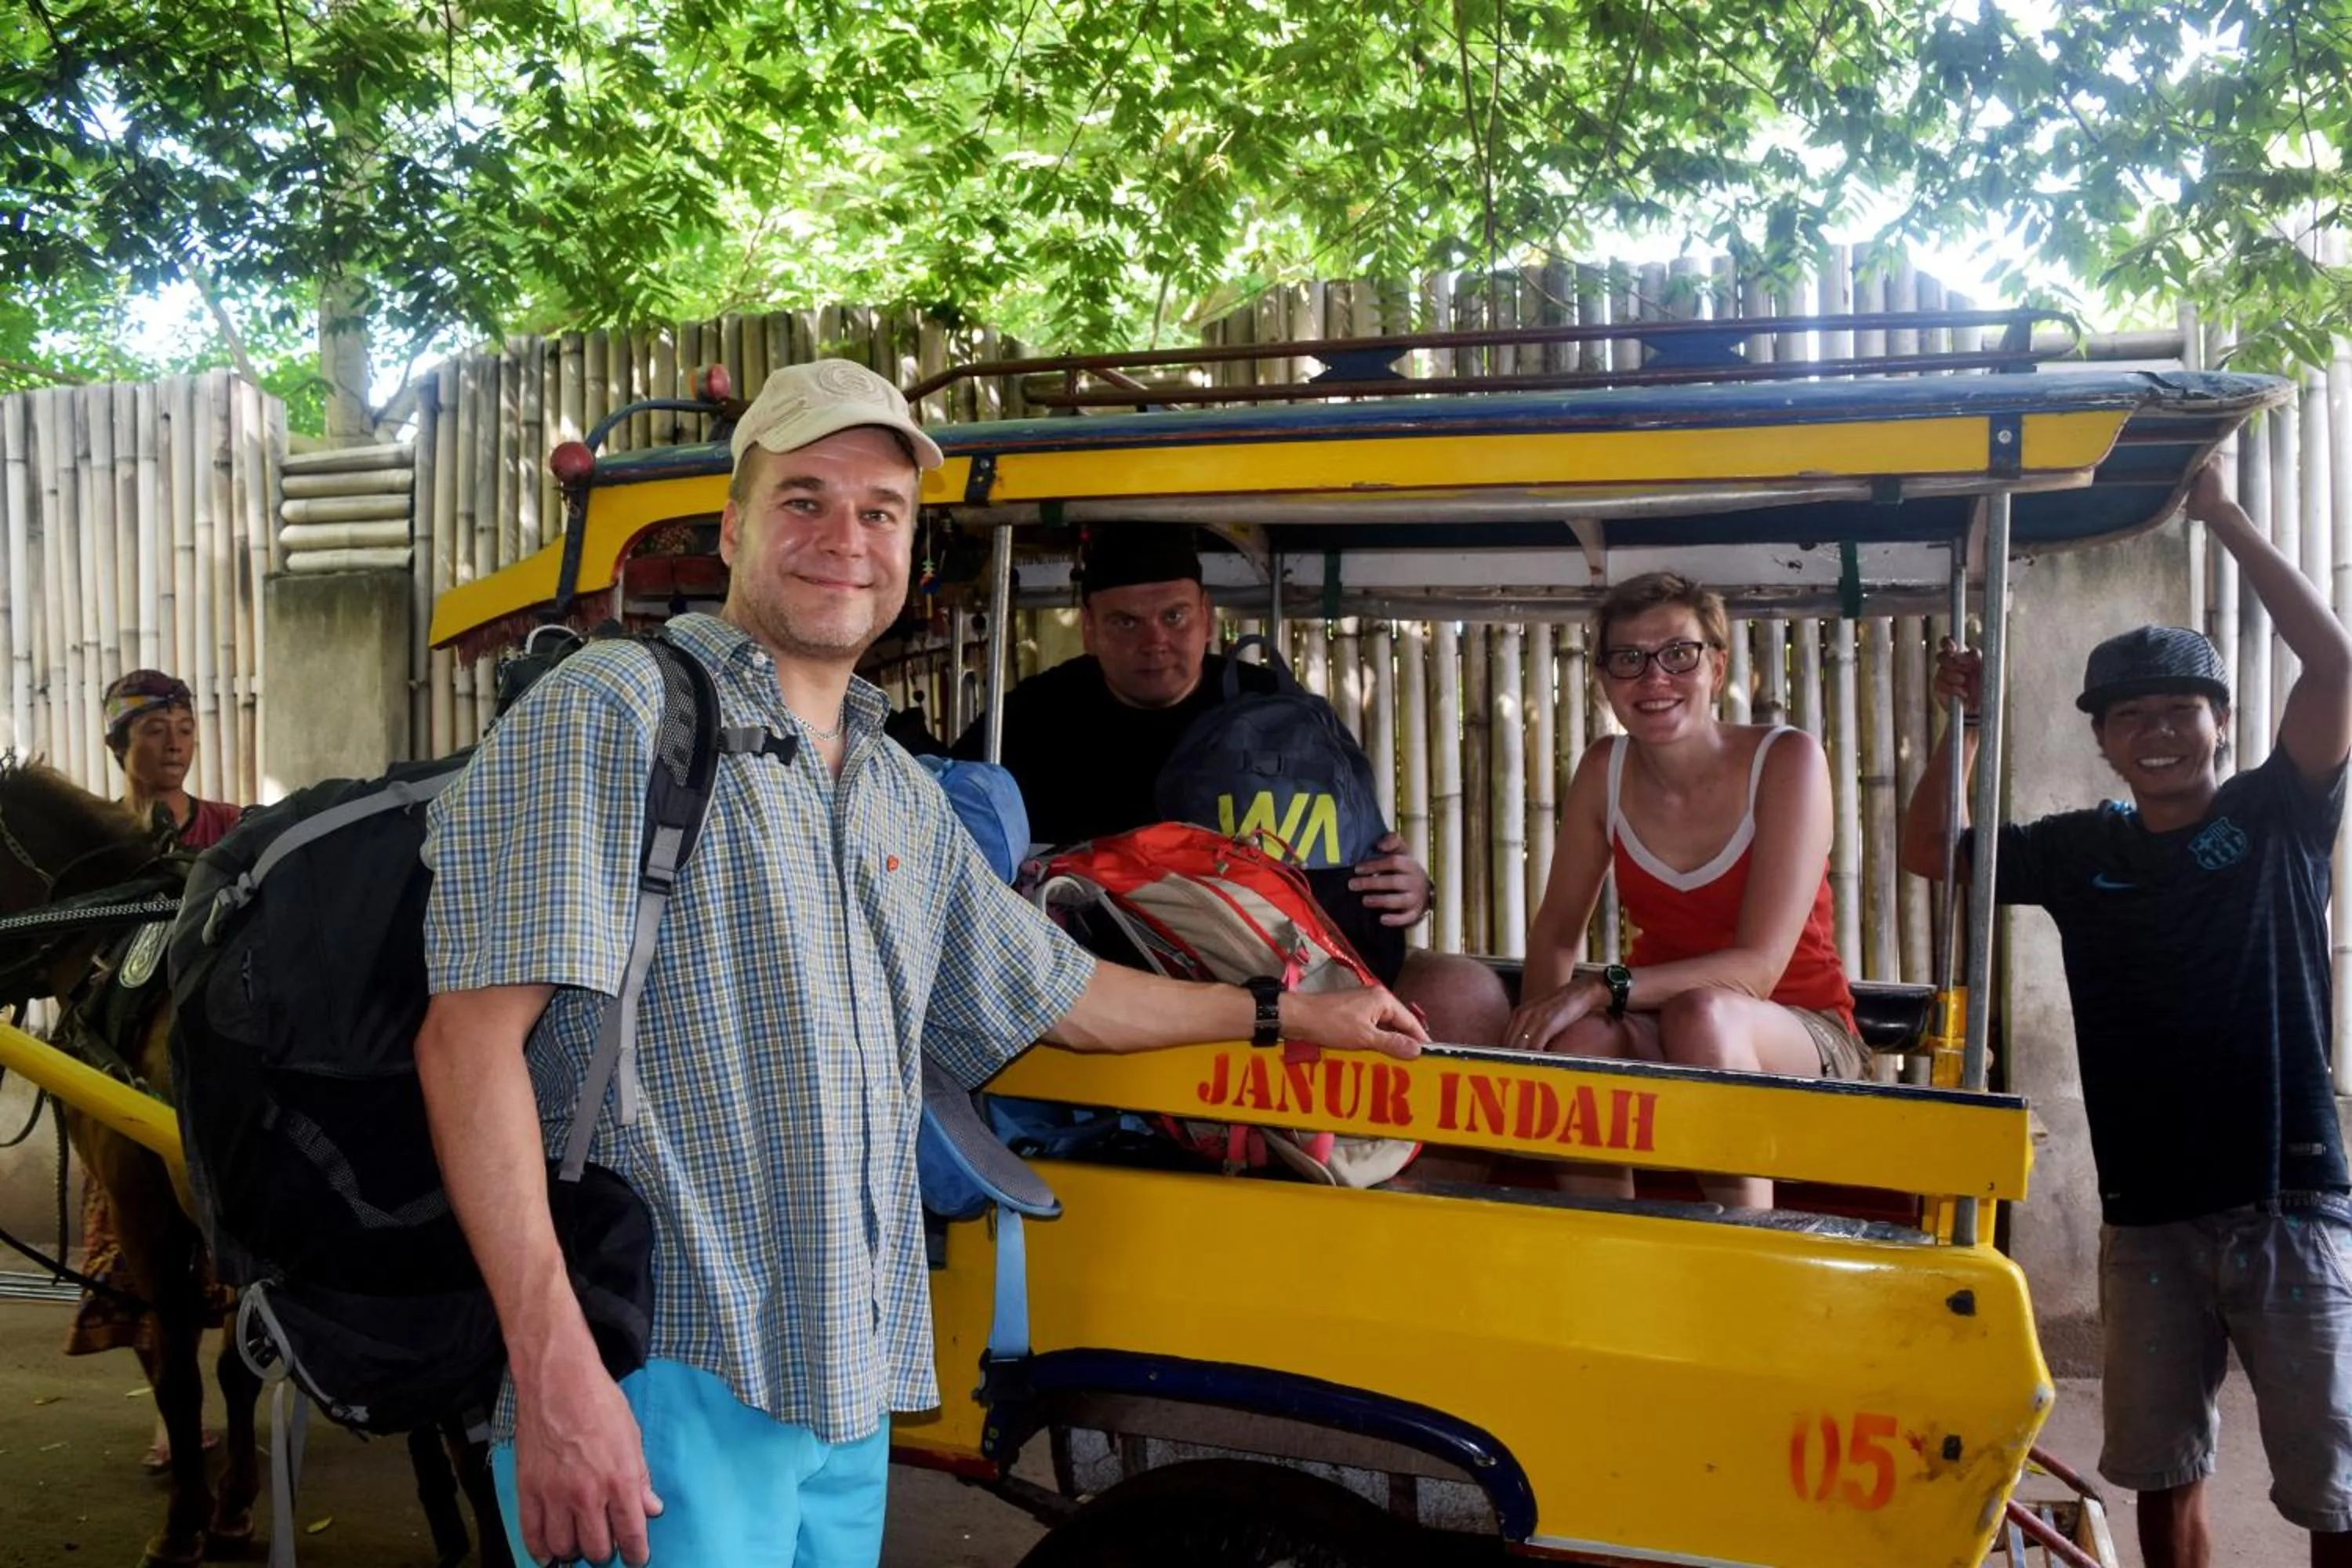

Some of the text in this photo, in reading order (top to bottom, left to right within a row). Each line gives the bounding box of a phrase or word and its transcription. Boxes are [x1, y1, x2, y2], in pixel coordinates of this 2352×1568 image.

[1197, 1054, 1658, 1152] JANUR INDAH
[1790, 1411, 1898, 1512] 05
